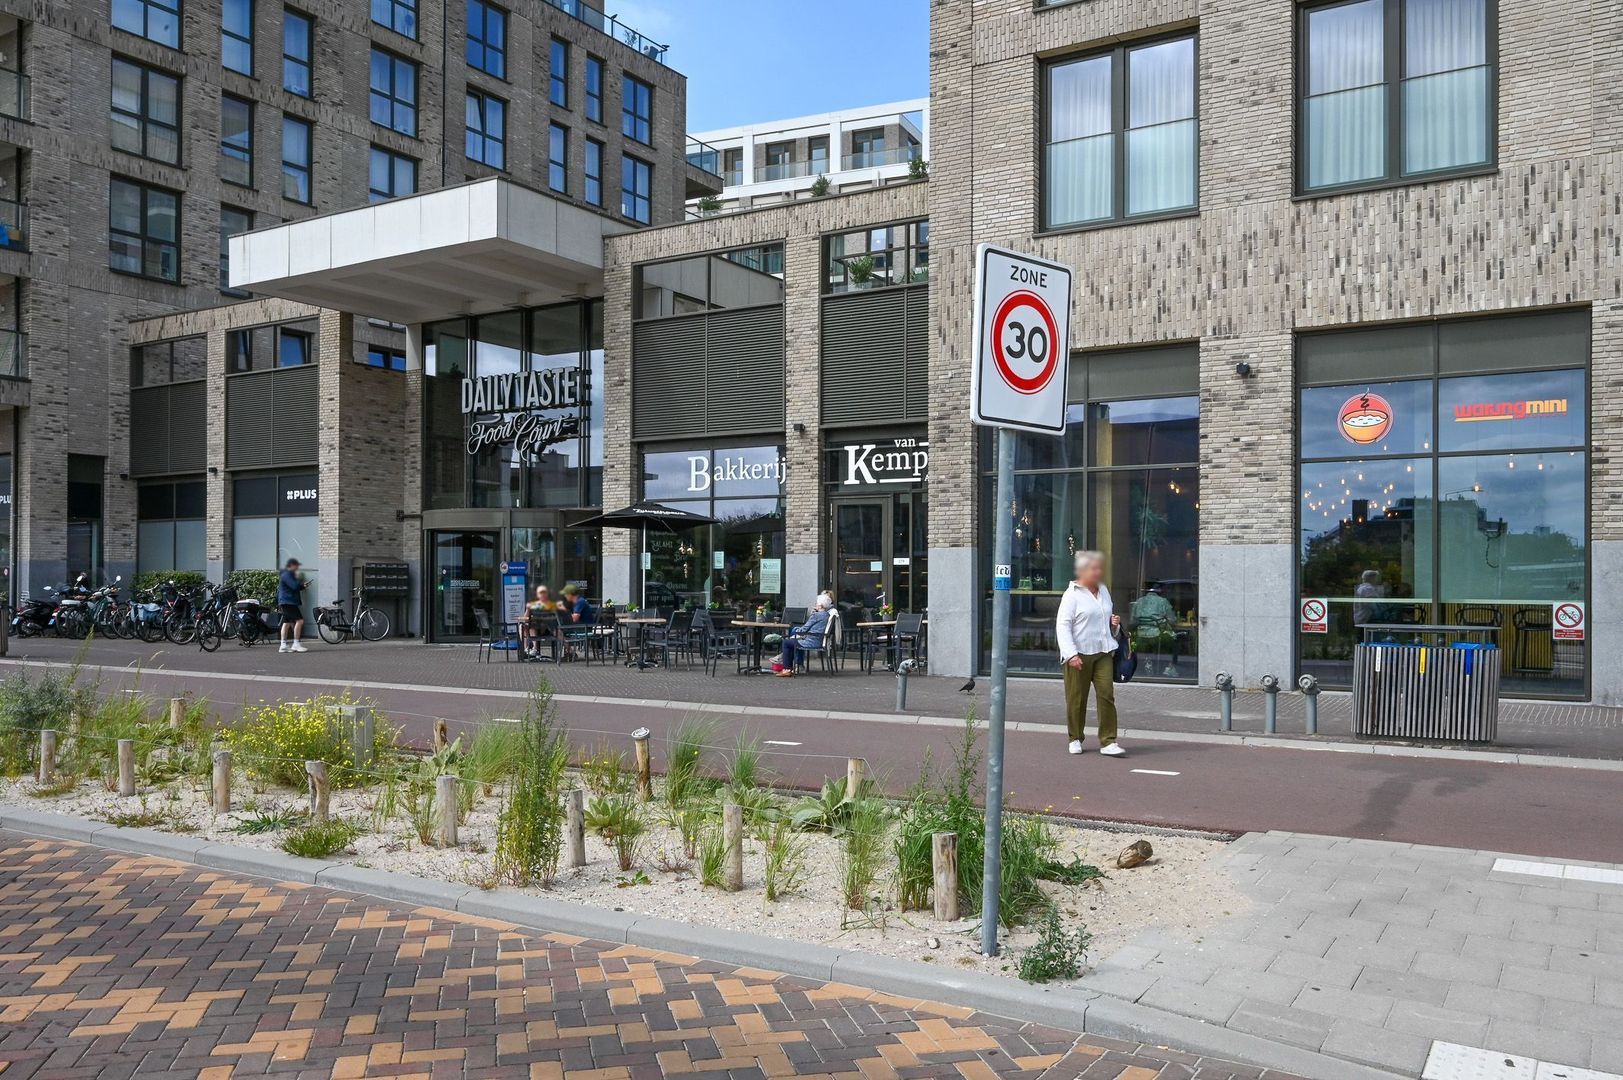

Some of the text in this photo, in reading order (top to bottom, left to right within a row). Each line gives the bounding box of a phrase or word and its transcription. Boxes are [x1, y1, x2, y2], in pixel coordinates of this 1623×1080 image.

[1010, 264, 1048, 289] ZONE
[1005, 321, 1048, 364] 30
[461, 365, 576, 415] DAILY TASTE
[466, 411, 573, 462] Food Court
[893, 438, 916, 448] van
[687, 455, 787, 492] Bakkerij
[843, 443, 929, 486] Kemp
[293, 489, 317, 500] PLUS
